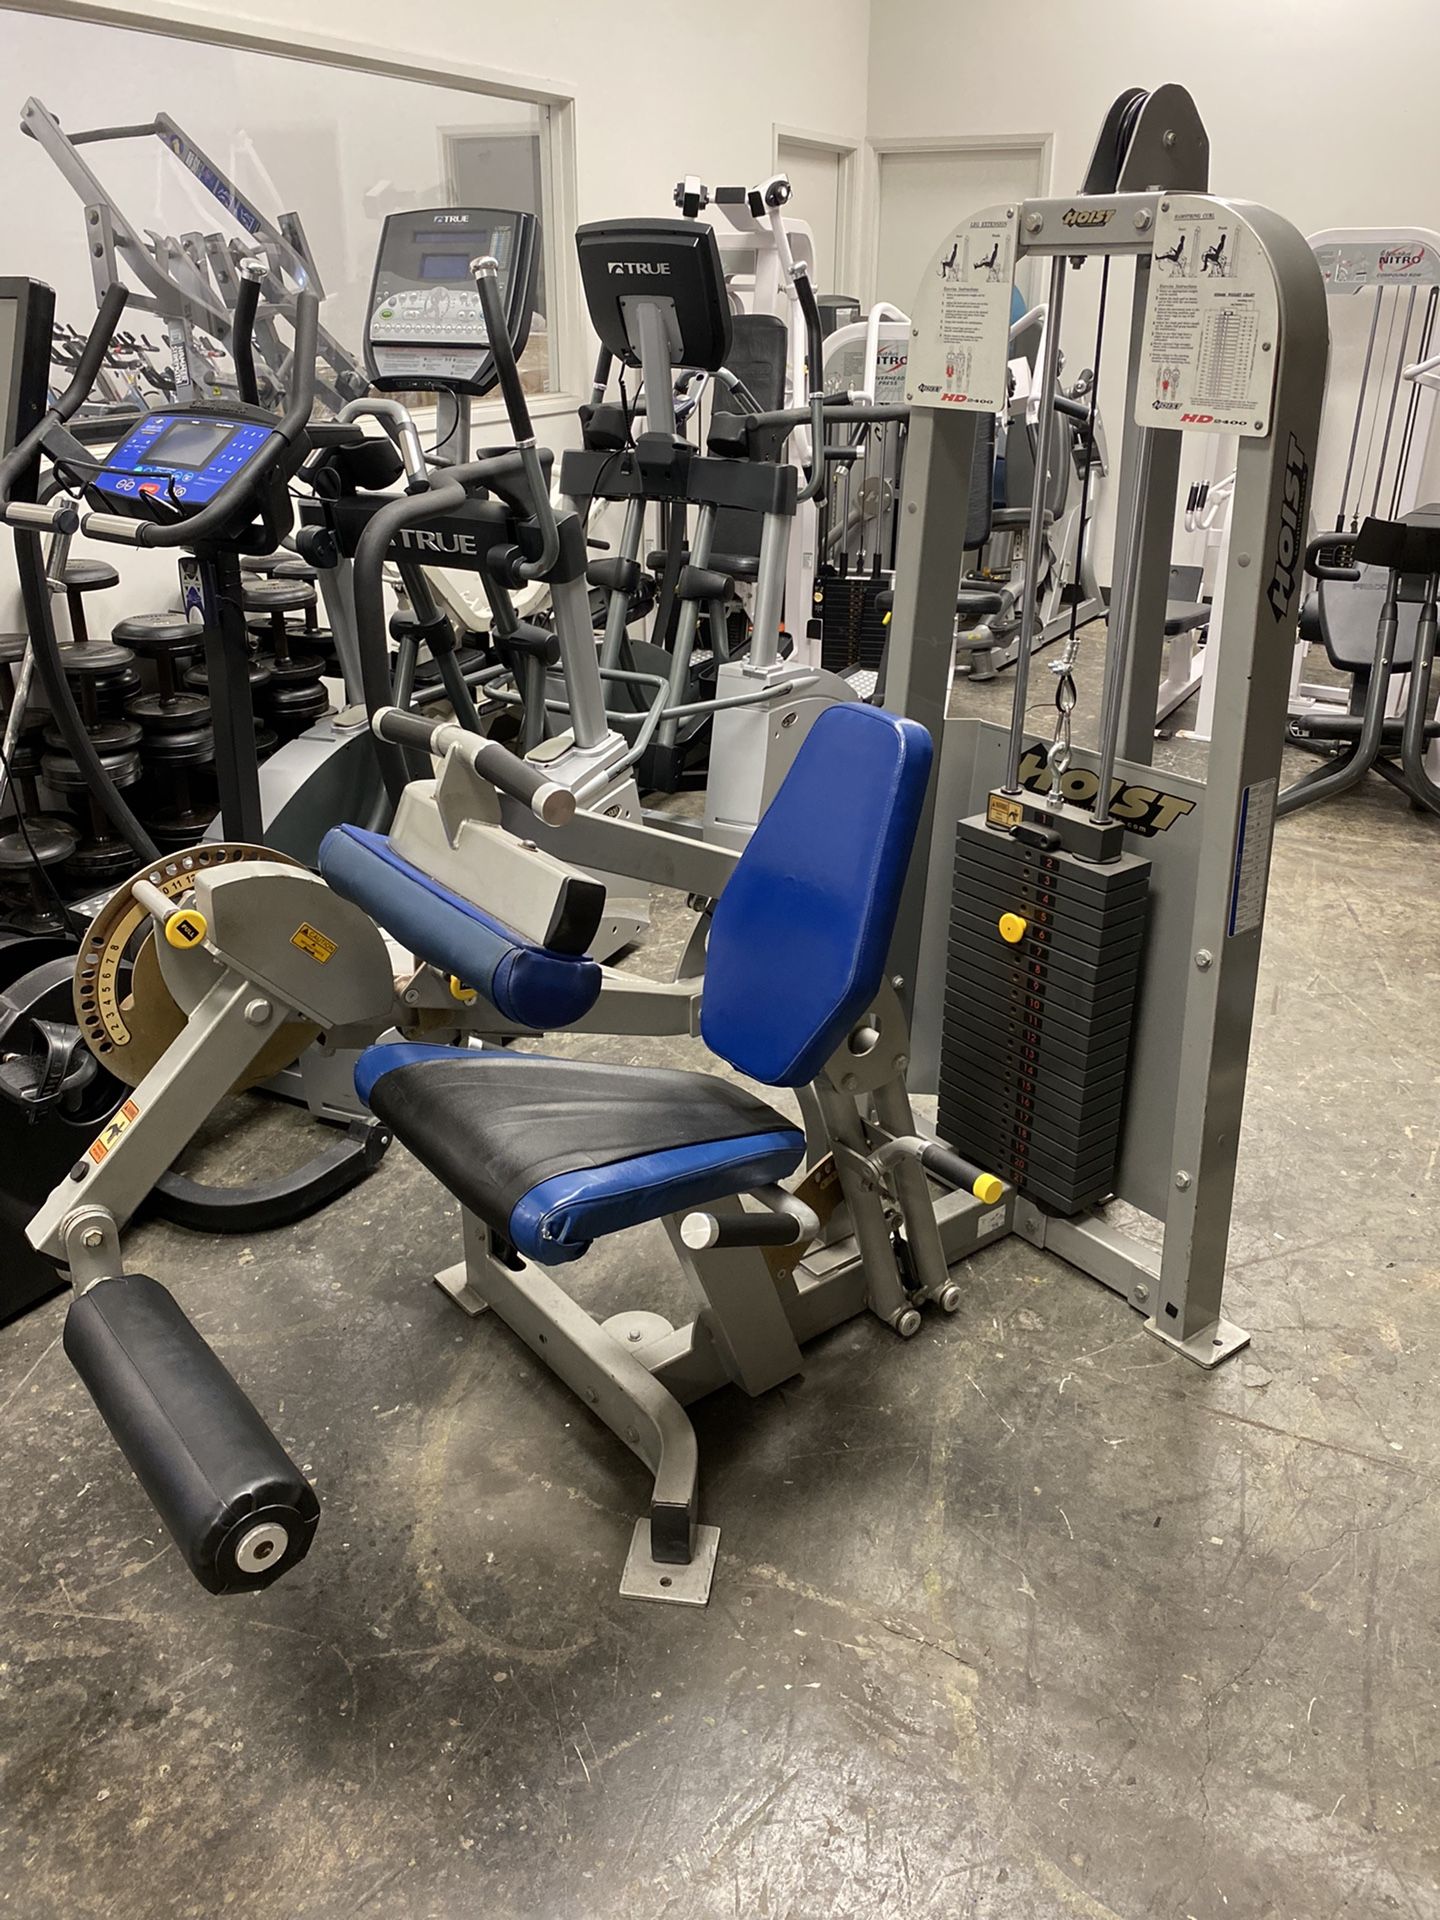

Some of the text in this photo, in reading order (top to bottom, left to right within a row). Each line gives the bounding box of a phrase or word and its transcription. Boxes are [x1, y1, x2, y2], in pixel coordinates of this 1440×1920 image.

[444, 215, 470, 223] TRUE
[1062, 208, 1117, 226] HOIST
[1379, 255, 1421, 264] NITRO
[624, 262, 671, 275] TRUE
[877, 356, 908, 365] ITRO
[1268, 432, 1306, 620] HOIST
[399, 528, 478, 555] TRUE
[162, 886, 170, 894] 0
[172, 879, 183, 889] 11
[180, 923, 195, 938] PULL
[103, 999, 111, 1007] 4
[1030, 998, 1040, 1009] 10
[1029, 1014, 1038, 1026] 11
[1027, 1031, 1037, 1043] 12
[1025, 1047, 1035, 1059] 13
